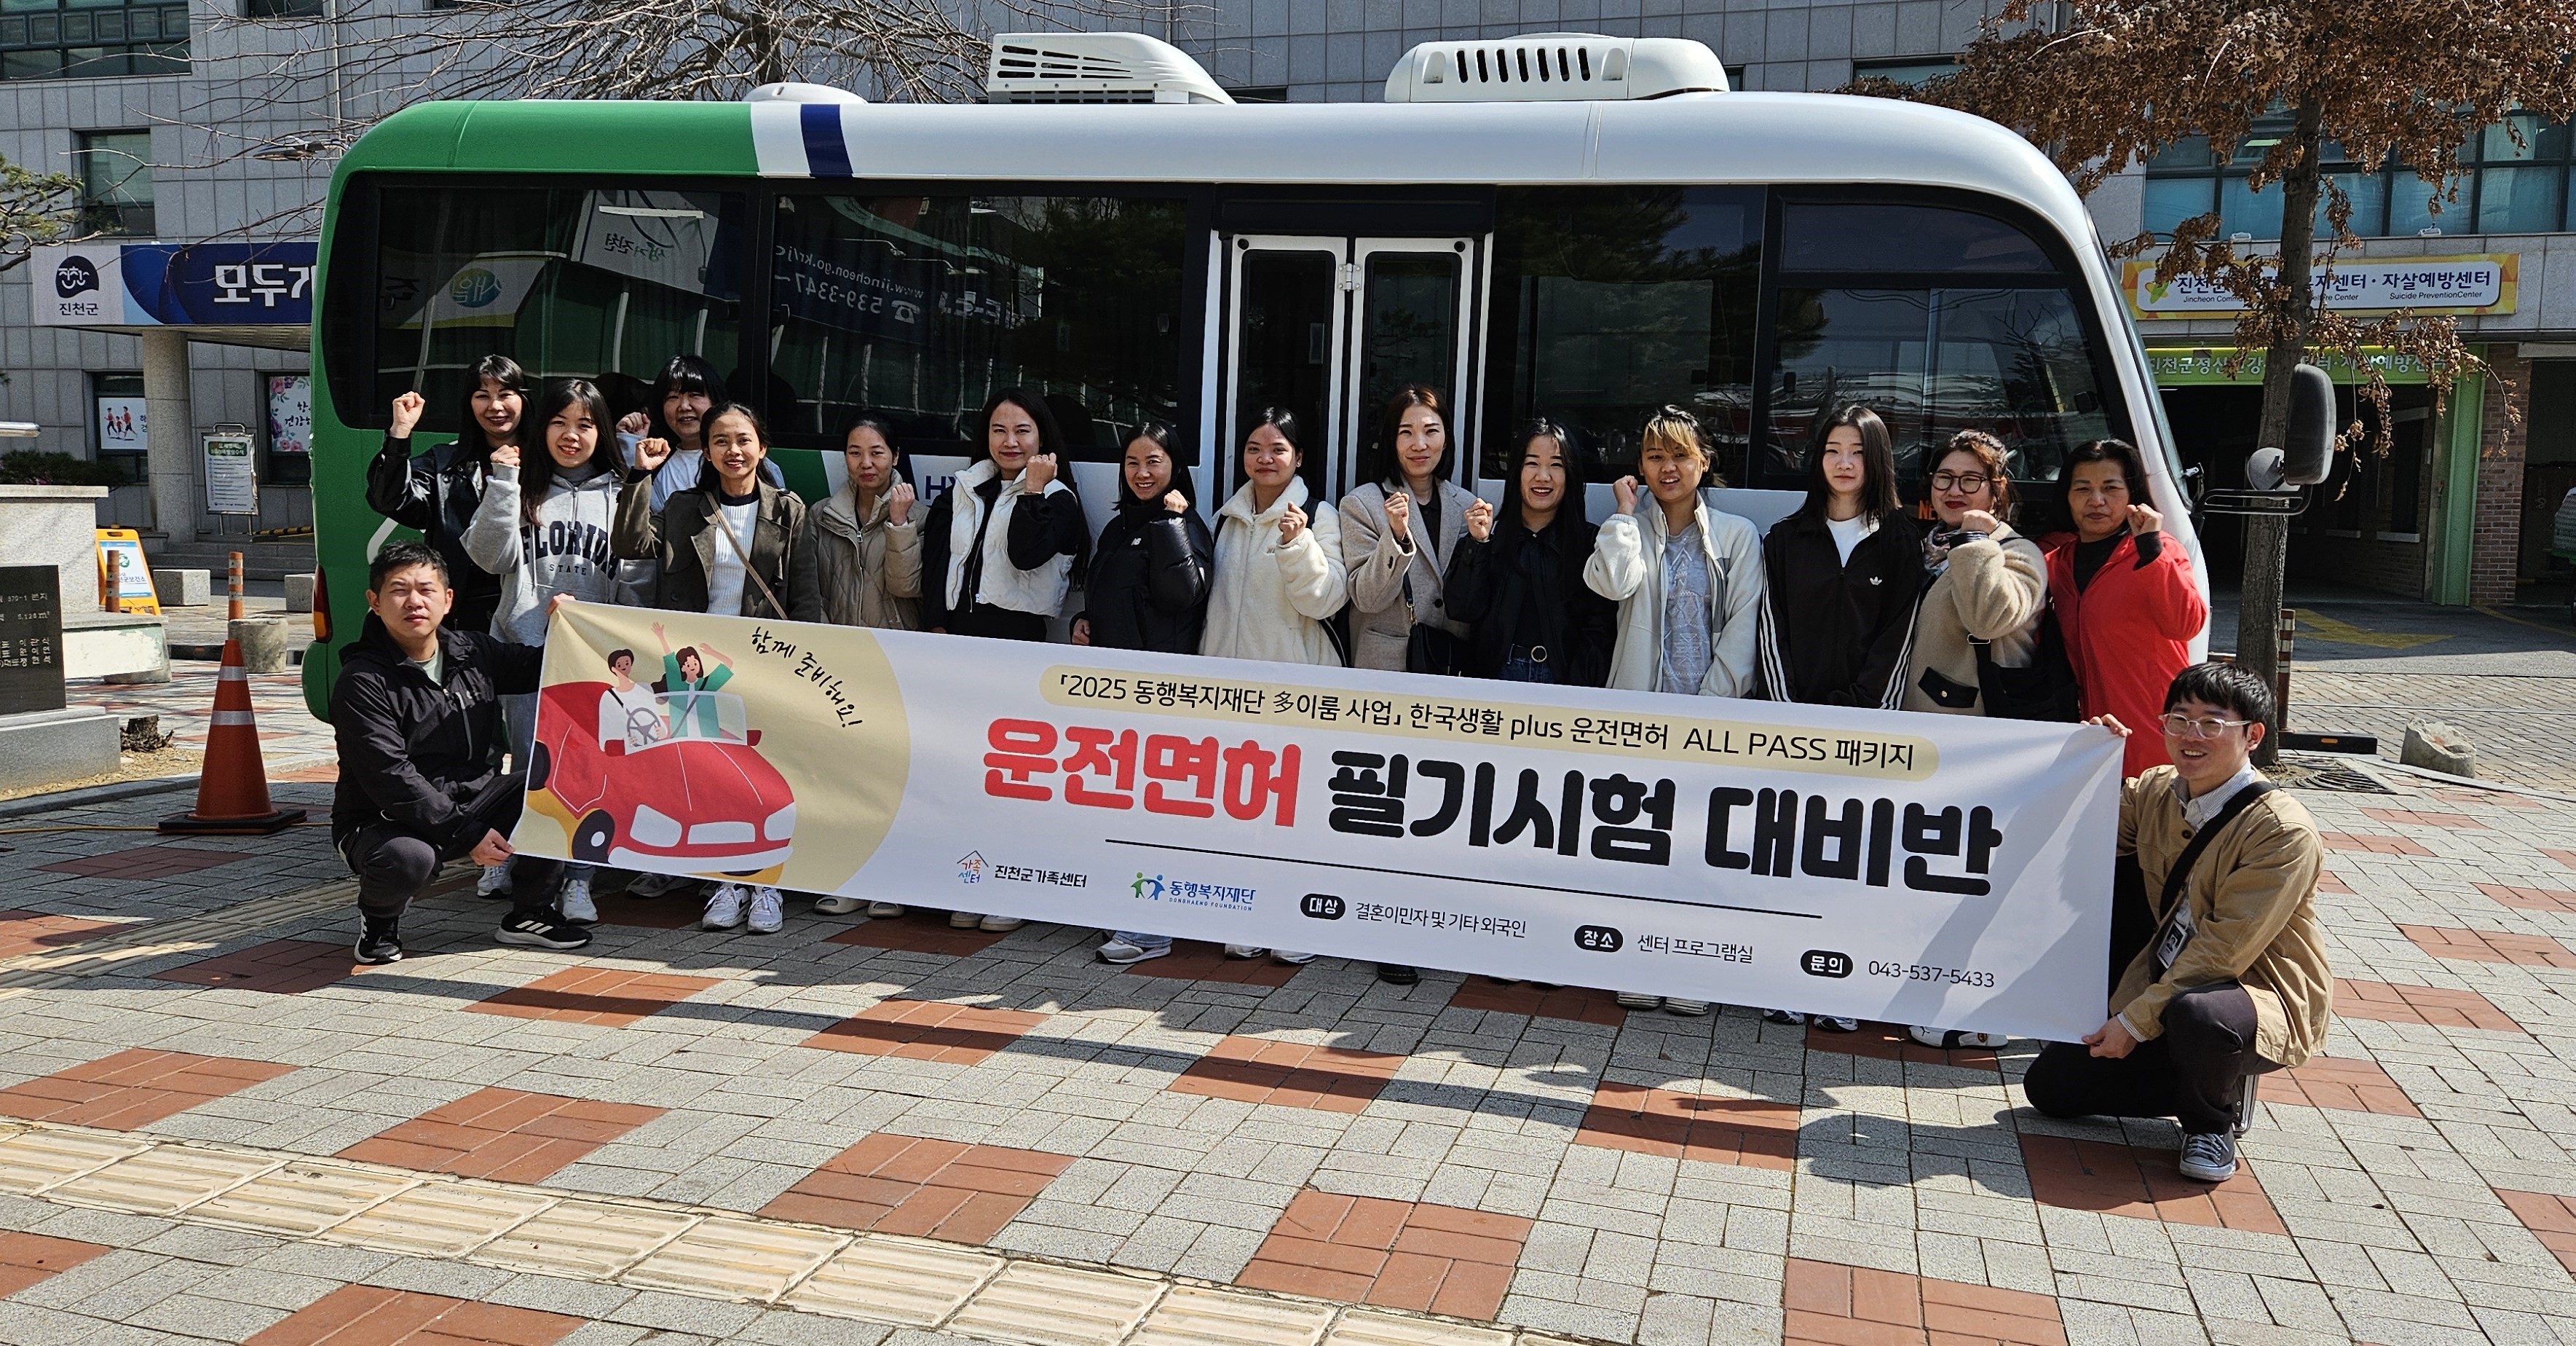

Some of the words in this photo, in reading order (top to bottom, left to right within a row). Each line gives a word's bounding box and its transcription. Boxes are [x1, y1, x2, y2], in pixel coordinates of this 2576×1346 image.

[2382, 270, 2491, 291] 자살예방센터
[2390, 292, 2417, 300] Suicide
[59, 302, 99, 316] 진천군
[549, 564, 587, 576] STATE
[752, 626, 797, 658] 함께
[794, 652, 863, 728] 준비해요!
[1133, 680, 1265, 714] 동행복지재단
[1273, 690, 1340, 721] 多이룸
[1410, 703, 1504, 736] 한국생활
[1510, 715, 1563, 740] plus
[1570, 717, 1668, 749] 운전면허
[1683, 728, 1739, 754] ALL
[1748, 733, 1826, 761] PASS
[1834, 739, 1913, 771] 패키지
[984, 717, 1302, 827] 운전면허
[1328, 750, 1676, 867] 필기시험
[1704, 786, 2004, 897] 대비반
[957, 870, 981, 883] 센터
[961, 859, 981, 874] 가족
[995, 865, 1087, 888] 진천군가족센터
[1169, 881, 1257, 905] 동행복지재단
[1169, 897, 1209, 906] DONGHAENG
[1210, 902, 1252, 911] FOUNDATION
[1308, 897, 1338, 914] 대상
[1356, 902, 1429, 926] 결혼이민자
[1431, 911, 1445, 929] 및
[1448, 913, 1479, 932] 기타
[1480, 917, 1527, 938] 외국인
[1584, 930, 1613, 949] 장소
[1637, 934, 1670, 954] 센터
[1672, 938, 1753, 964] 프로그램실
[1811, 955, 1844, 975] 문의
[1868, 960, 1995, 988] 043-537-5433
